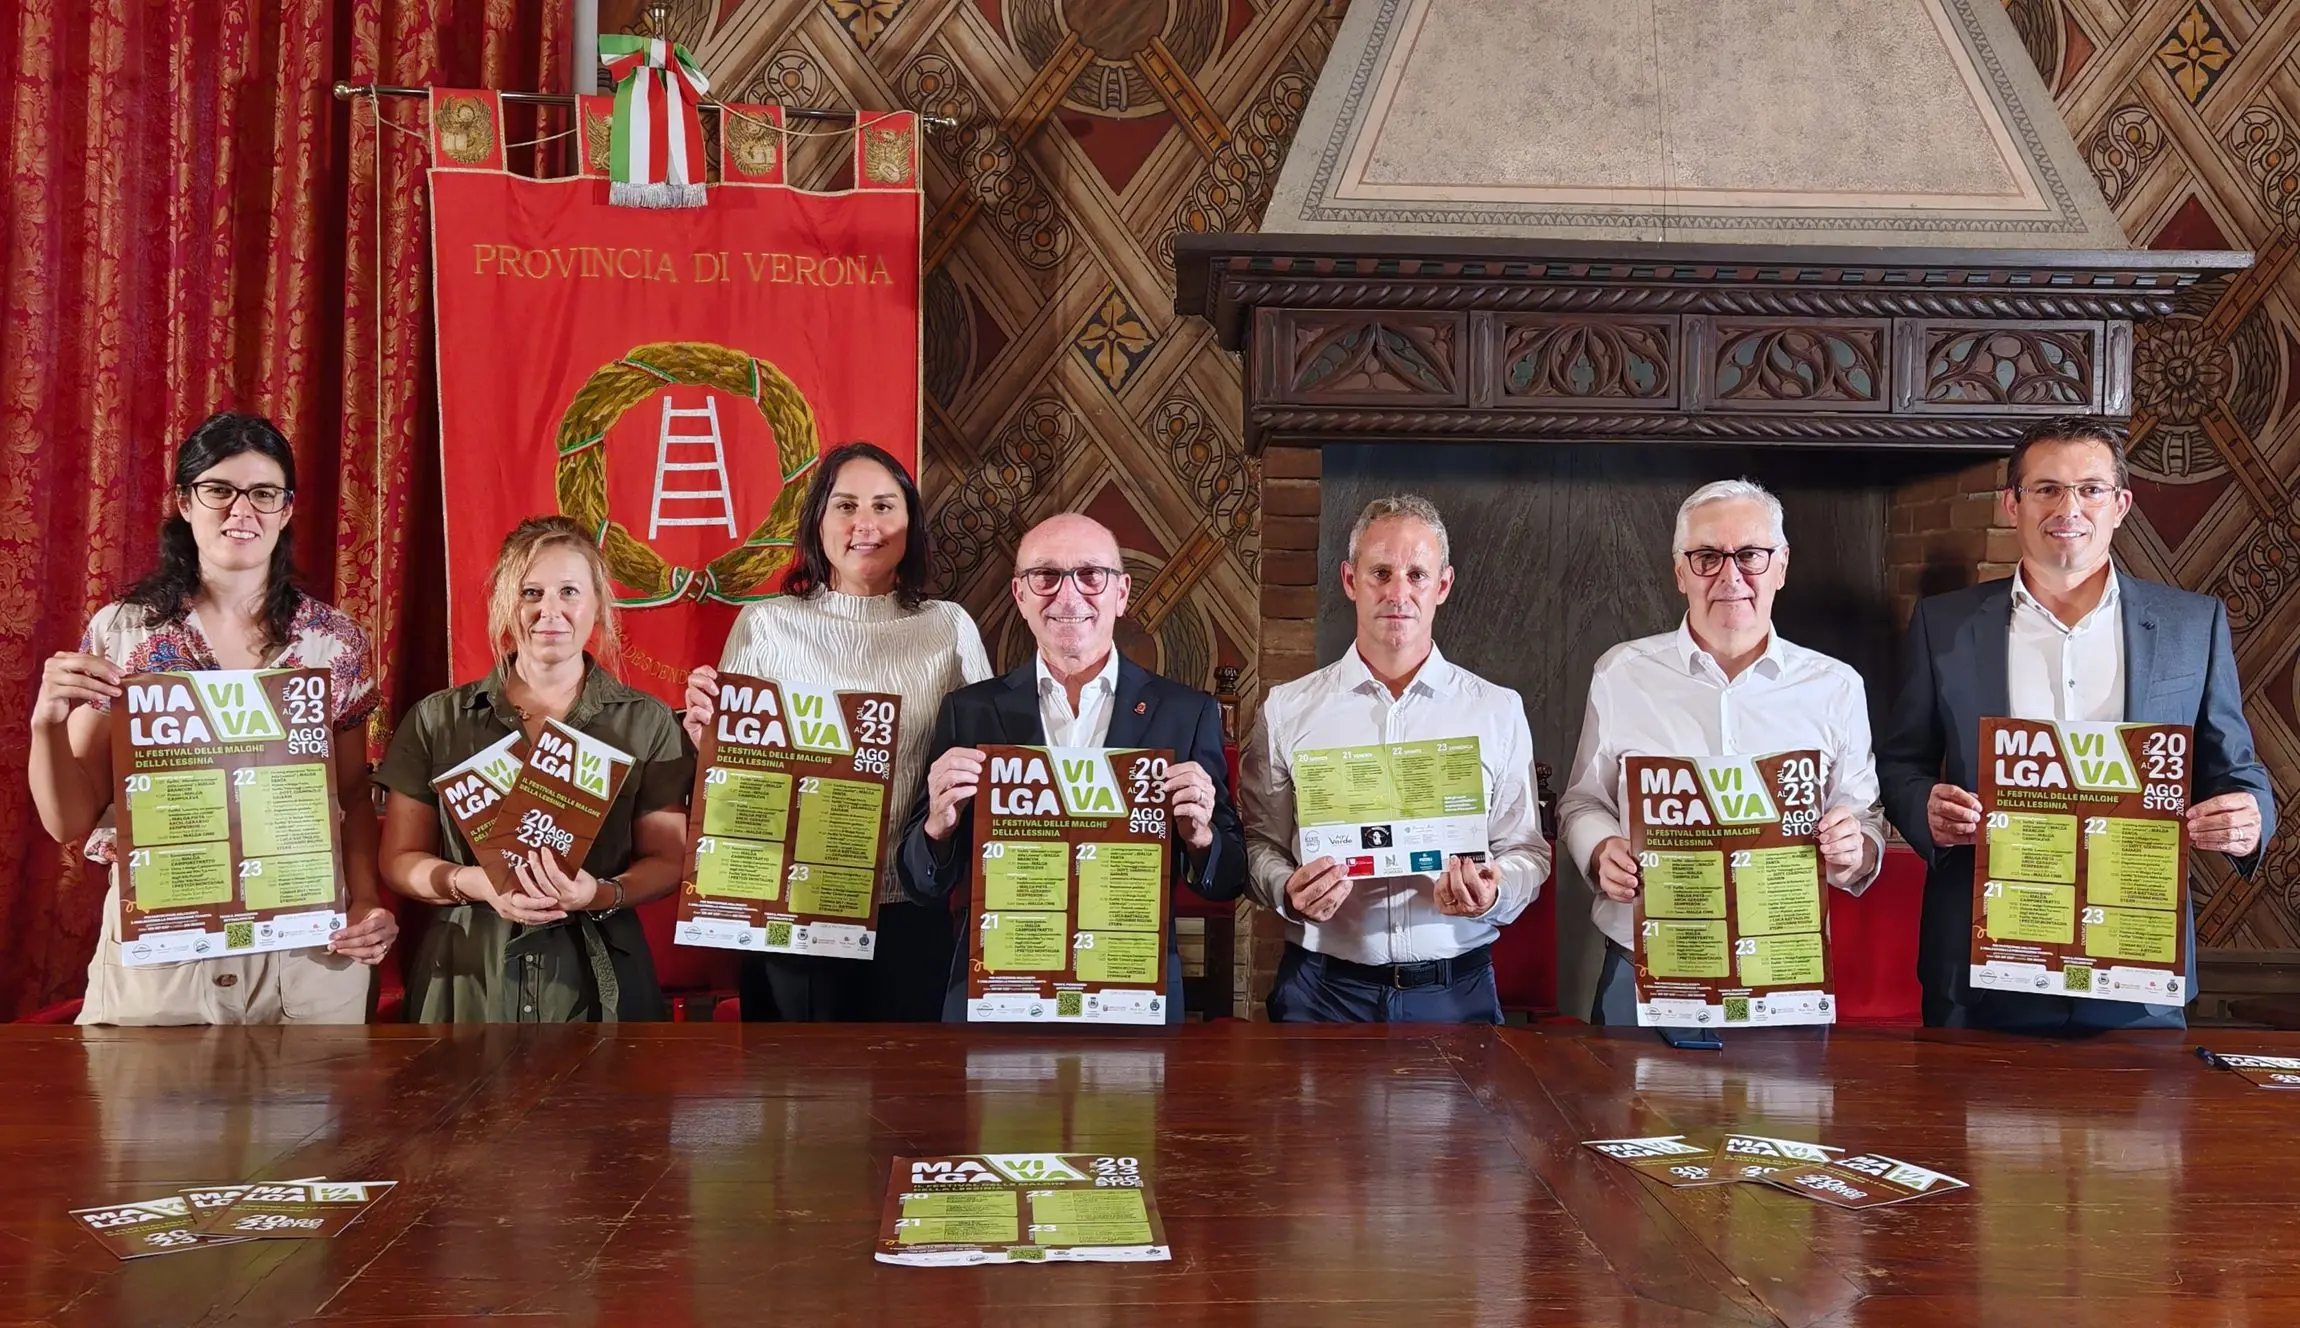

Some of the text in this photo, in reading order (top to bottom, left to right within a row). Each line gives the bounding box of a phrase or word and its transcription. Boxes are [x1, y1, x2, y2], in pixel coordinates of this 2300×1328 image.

[473, 243, 894, 286] PROVINCIA DI VERONA
[622, 645, 689, 684] DESCEND
[208, 683, 244, 707] VI
[289, 677, 325, 700] 20
[128, 685, 195, 713] MA
[720, 685, 778, 716] MA
[792, 692, 823, 718] VI
[291, 701, 324, 724] 23
[863, 700, 895, 723] 20
[130, 716, 211, 745] LGA
[222, 710, 271, 735] VA
[718, 715, 786, 747] LGA
[288, 728, 325, 741] AGO
[800, 720, 841, 748] VA
[860, 722, 892, 745] 23
[146, 748, 193, 757] FESTIVAL
[194, 746, 224, 754] DELLE
[225, 745, 264, 753] MALGHE
[288, 741, 321, 754] STO
[538, 732, 573, 761] MA
[1995, 729, 2056, 757] MA
[2070, 733, 2104, 757] VI
[2149, 732, 2186, 756] 20
[136, 757, 214, 768] DELLA LESSINIA
[581, 751, 600, 771] VI
[717, 755, 784, 768] DELLA LESSINIA
[727, 747, 768, 757] FESTIVAL
[769, 751, 795, 760] DELLE
[796, 753, 832, 764] MALGHE
[854, 747, 889, 762] AGO
[484, 758, 508, 778] VI
[530, 750, 571, 783] LGA
[853, 760, 883, 773] STO
[991, 757, 1049, 784] MA
[1062, 759, 1093, 783] VI
[1135, 758, 1168, 780] 20
[1783, 758, 1815, 782] 20
[1996, 759, 2067, 788] LGA
[2080, 760, 2127, 785] VA
[2149, 756, 2184, 780] 23
[125, 775, 151, 793] 20
[233, 769, 256, 786] 22
[580, 770, 604, 793] VA
[705, 769, 727, 784] 20
[799, 777, 819, 793] 22
[1641, 768, 1697, 794] MA
[1709, 768, 1742, 792] VI
[445, 774, 484, 805] MA
[519, 784, 566, 810] DELLA LESSINIA
[1072, 786, 1115, 810] VA
[1134, 780, 1166, 803] 23
[1784, 782, 1815, 806] 23
[2007, 791, 2049, 799] FESTIVAL
[2051, 793, 2079, 801] DELLE
[2080, 794, 2119, 802] MALGHE
[2144, 783, 2183, 797] AGO
[455, 787, 501, 820] LGA
[528, 779, 558, 798] FESTIVAL
[557, 792, 575, 806] DELLE
[575, 800, 601, 818] MALGHE
[991, 788, 1060, 816] LGA
[1721, 793, 1766, 818] VA
[1997, 799, 2067, 810] DELLA LESSINIA
[2143, 797, 2176, 810] STO
[1129, 808, 1165, 820] AGO
[1643, 798, 1711, 825] LGA
[1782, 810, 1816, 824] AGO
[525, 809, 553, 832] 20
[1044, 820, 1069, 828] DELLE
[1129, 821, 1159, 833] STO
[1987, 812, 2009, 829] 20
[2084, 818, 2106, 834] 22
[517, 826, 544, 848] 23
[550, 825, 574, 843] AGO
[1655, 829, 1694, 837] FESTIVAL
[1695, 829, 1722, 837] DELLE
[1724, 828, 1760, 836] MALGHE
[1782, 823, 1812, 836] STO
[544, 835, 565, 851] STO
[697, 838, 715, 853] 21
[982, 843, 1004, 858] 20
[129, 851, 150, 867] 21
[1076, 845, 1096, 860] 22
[1639, 852, 1659, 867] 20
[1730, 852, 1751, 867] 22
[239, 860, 262, 877] 23
[788, 864, 808, 881] 23
[1984, 882, 2002, 898] 21
[981, 913, 998, 929] 21
[2081, 908, 2104, 924] 23
[1642, 921, 1659, 936] 21
[1073, 933, 1094, 948] 23
[1735, 940, 1756, 955] 23
[912, 1161, 987, 1173] MA
[1003, 1160, 1044, 1170] VI
[1096, 1158, 1138, 1167] 20
[1099, 1167, 1138, 1175] 23
[912, 1173, 1002, 1183] LGA
[1017, 1170, 1074, 1179] VA
[243, 1194, 306, 1202] LGA
[895, 1219, 920, 1227] 21
